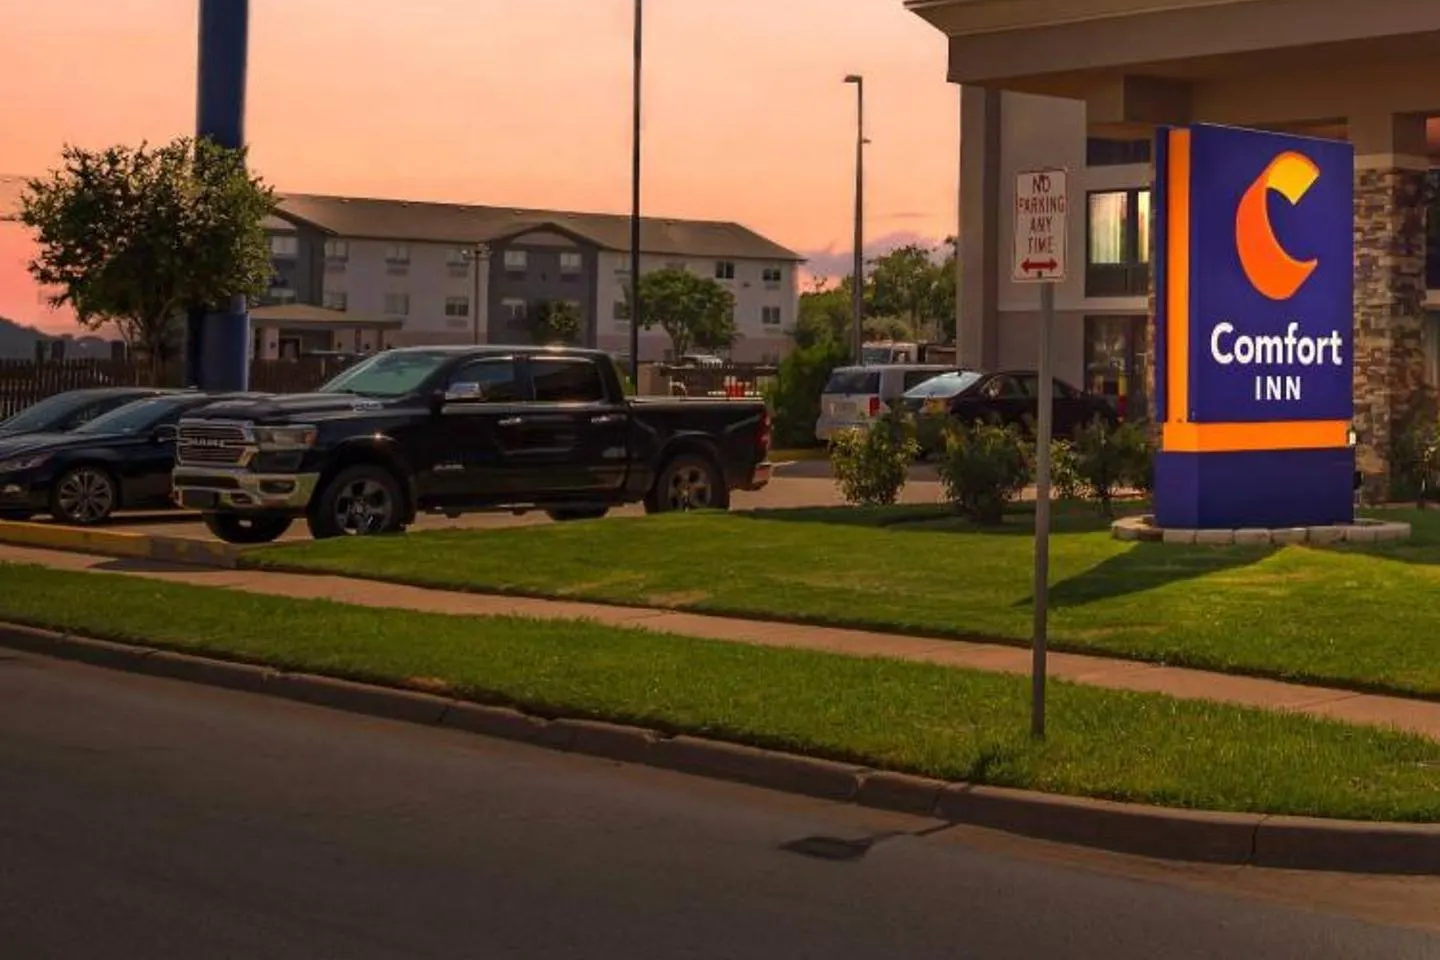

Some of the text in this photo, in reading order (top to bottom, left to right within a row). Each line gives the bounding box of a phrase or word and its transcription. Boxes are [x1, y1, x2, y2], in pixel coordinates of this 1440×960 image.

[1032, 175, 1052, 193] NO
[1018, 196, 1065, 213] PARKING
[1030, 216, 1052, 233] ANY
[1028, 236, 1054, 253] TIME
[1211, 322, 1343, 366] Comfort
[1255, 376, 1301, 400] INN
